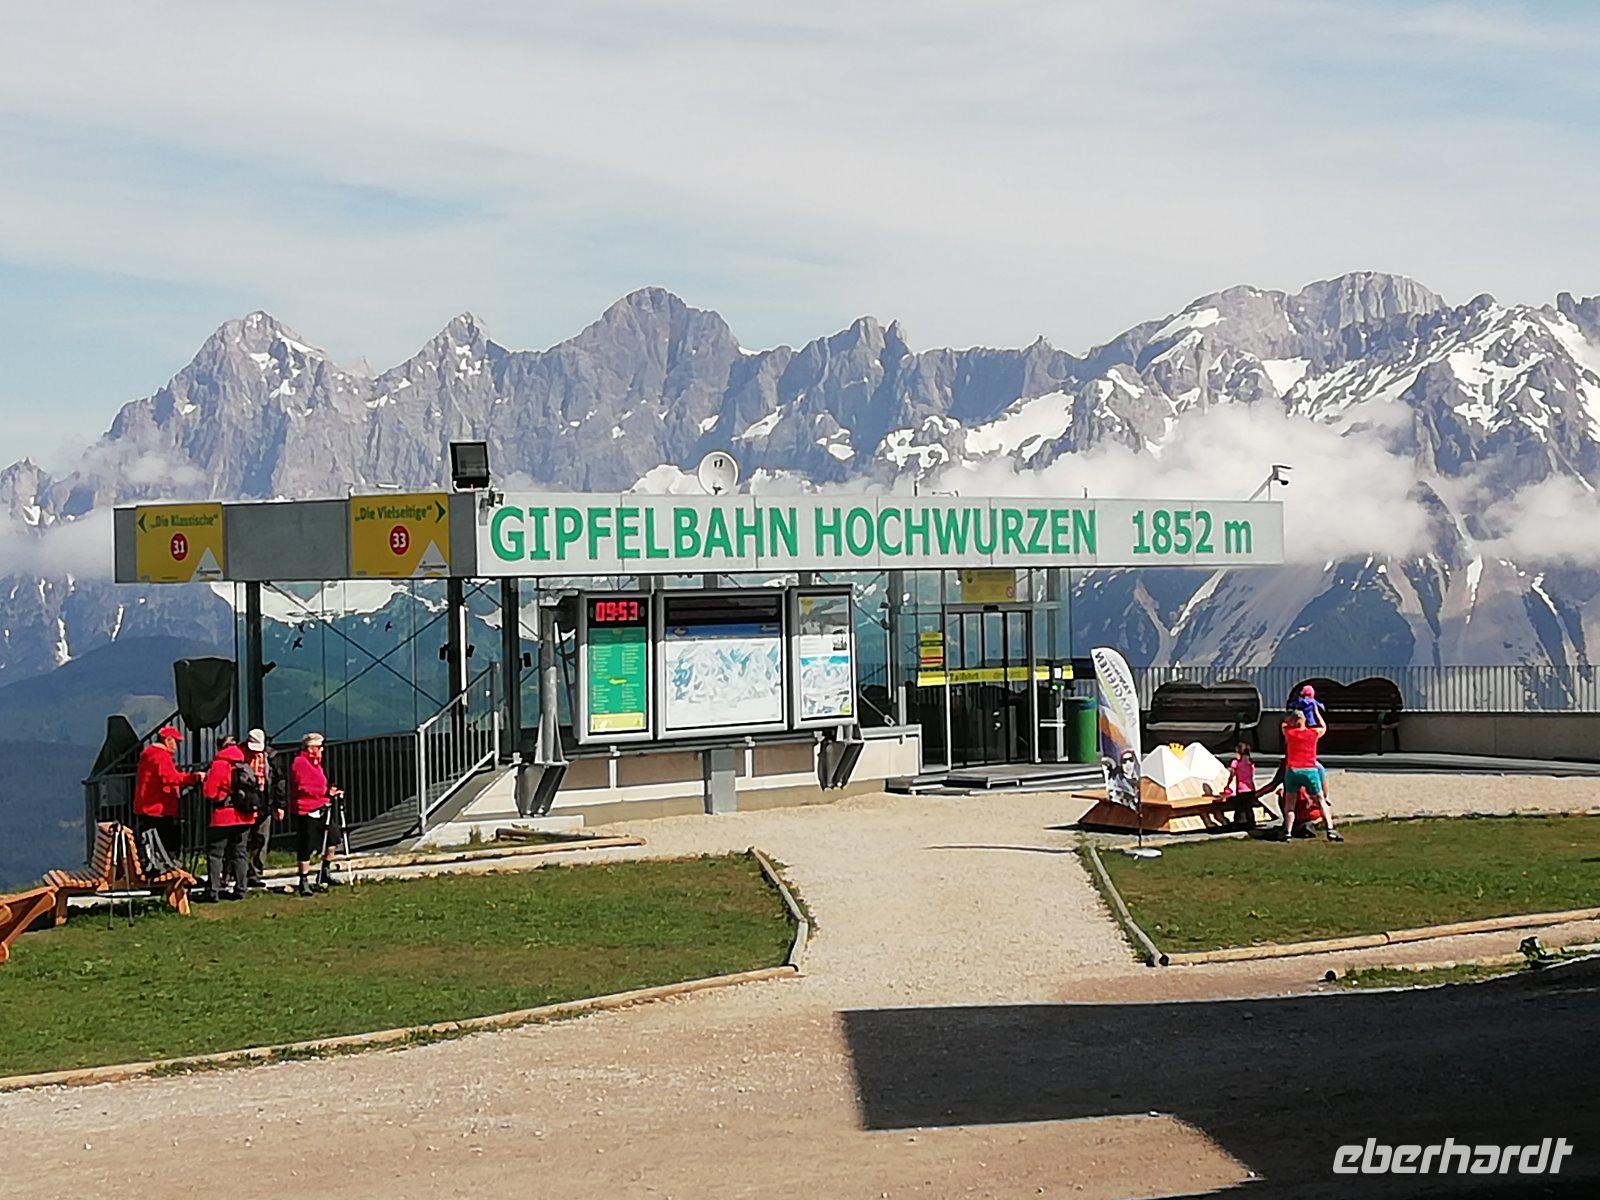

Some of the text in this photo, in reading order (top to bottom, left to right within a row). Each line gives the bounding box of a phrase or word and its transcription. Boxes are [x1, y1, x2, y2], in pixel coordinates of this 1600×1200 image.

[392, 532, 407, 548] 33
[490, 506, 1253, 561] GIPFELBAHN HOCHWURZEN 1852 m
[173, 540, 185, 555] 31
